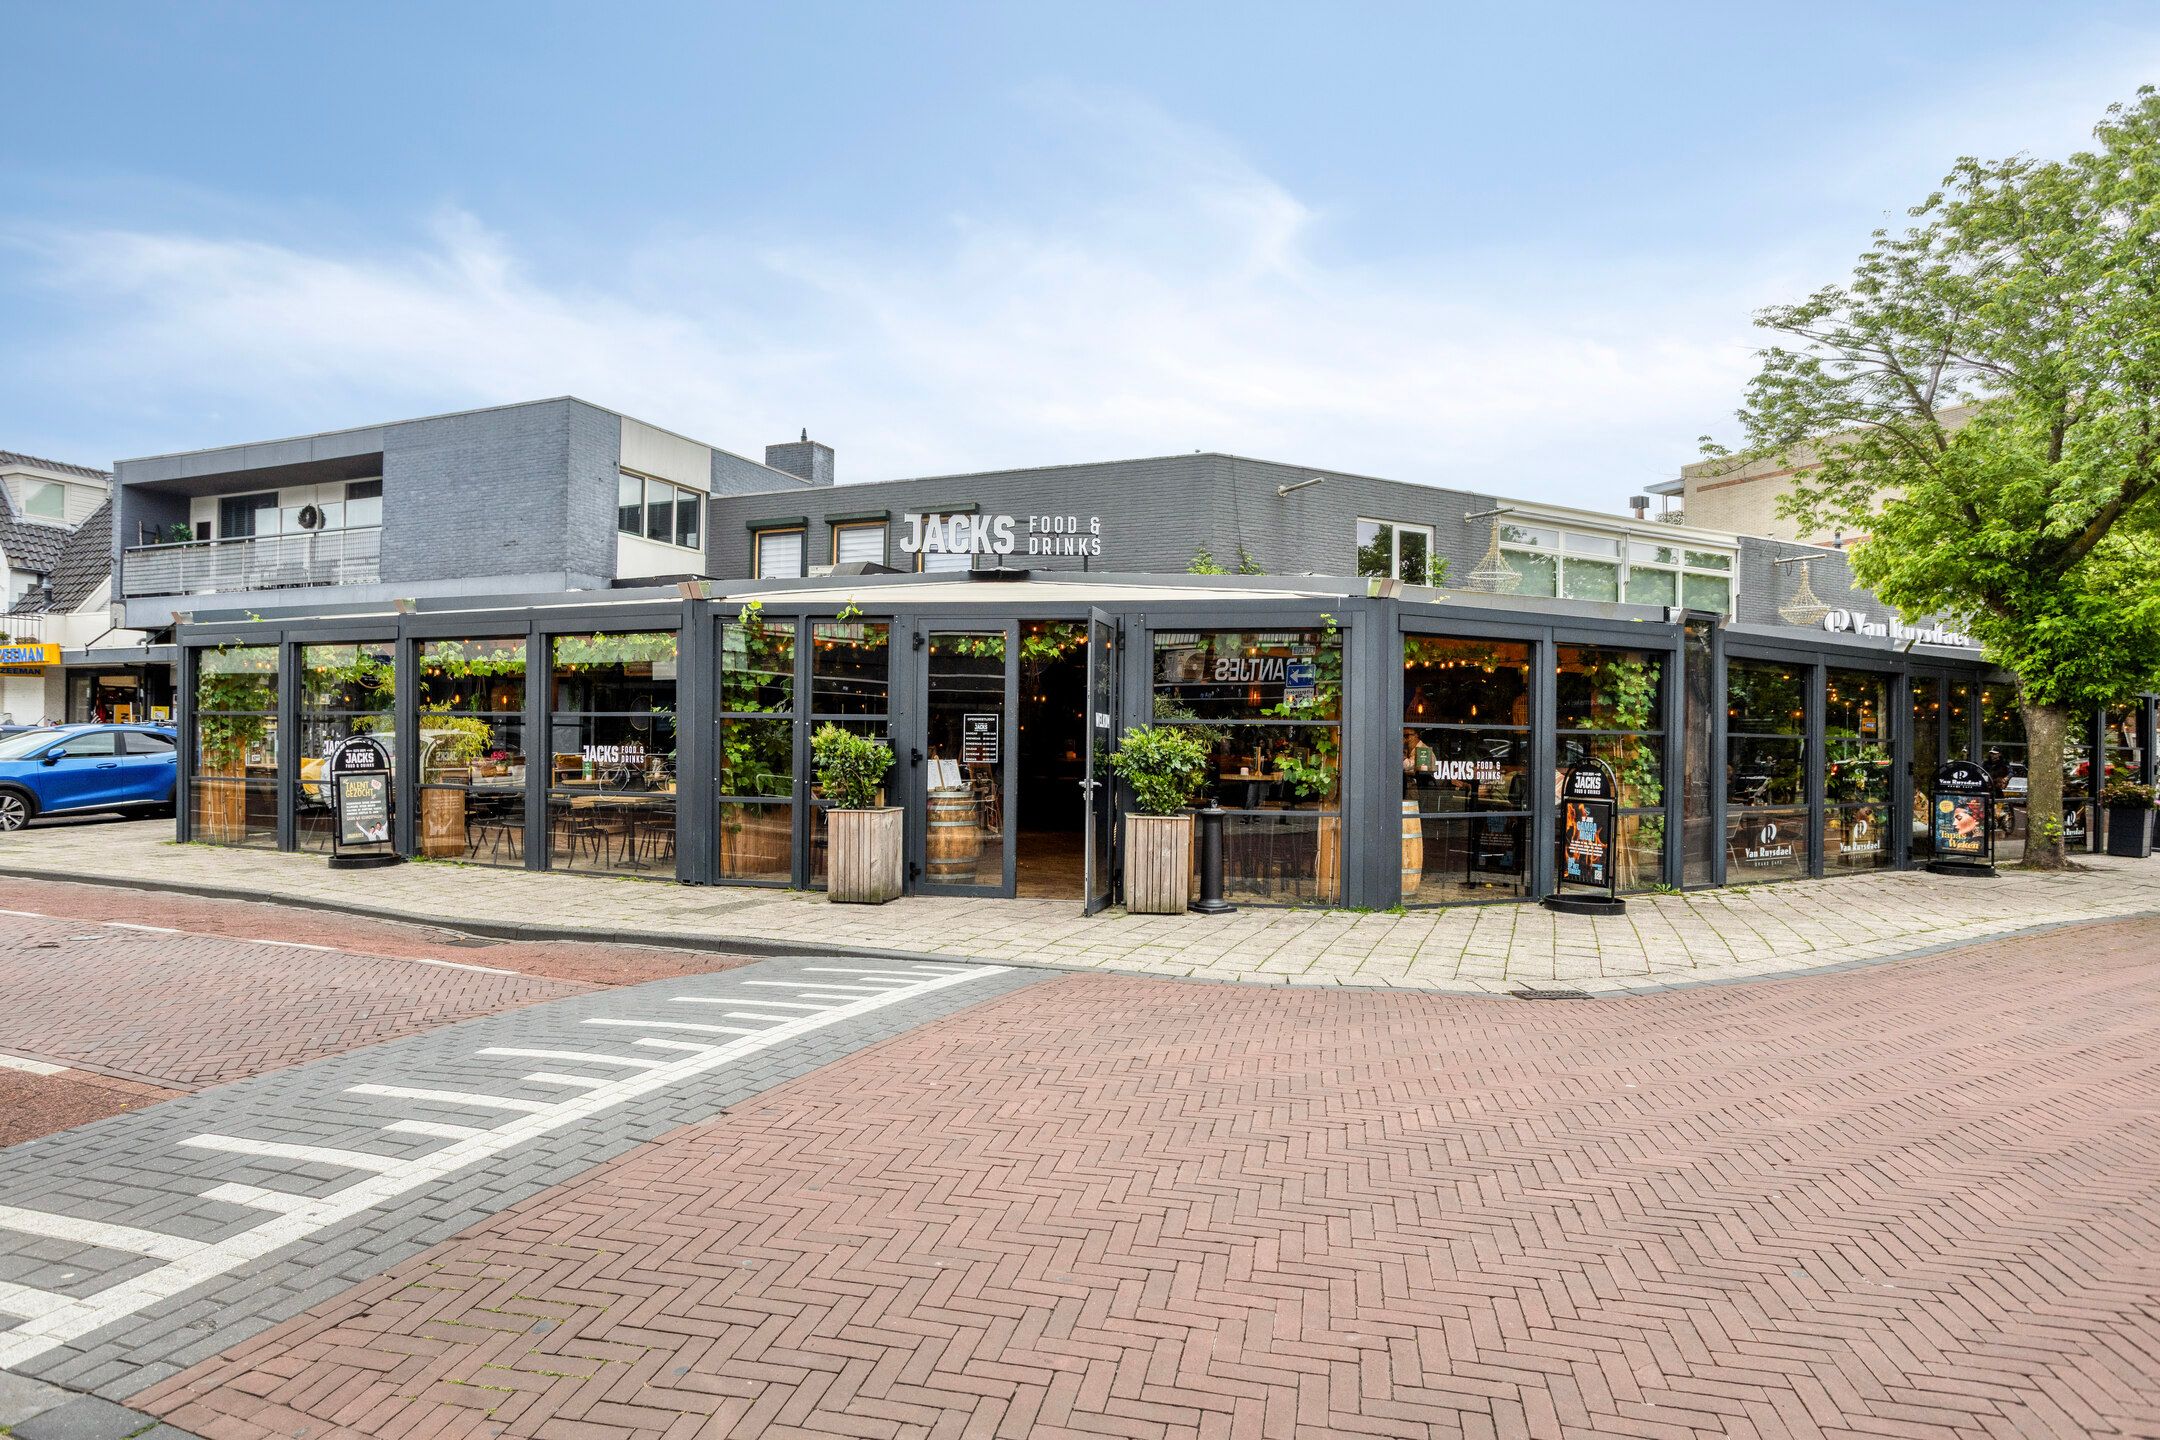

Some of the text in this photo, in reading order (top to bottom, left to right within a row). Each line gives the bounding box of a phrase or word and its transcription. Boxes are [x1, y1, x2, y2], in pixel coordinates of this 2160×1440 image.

[1029, 515, 1101, 535] FOOD &
[900, 513, 1015, 554] JACKS
[1029, 537, 1101, 556] DRINKS
[1851, 612, 1887, 637] Van
[581, 745, 619, 763] JACKS
[621, 746, 636, 754] FOOD
[345, 752, 374, 764] JACKS
[621, 755, 644, 763] DRINKS
[1433, 760, 1475, 780] JACKS
[1476, 761, 1493, 770] FOOD
[1476, 771, 1500, 780] DRINKS
[1574, 776, 1601, 789] JACKS
[1941, 831, 1967, 839] Tapas
[1840, 839, 1880, 852] Van Ruysdael
[1949, 840, 1979, 849] Weken
[1745, 845, 1791, 858] Van Ruysdael
